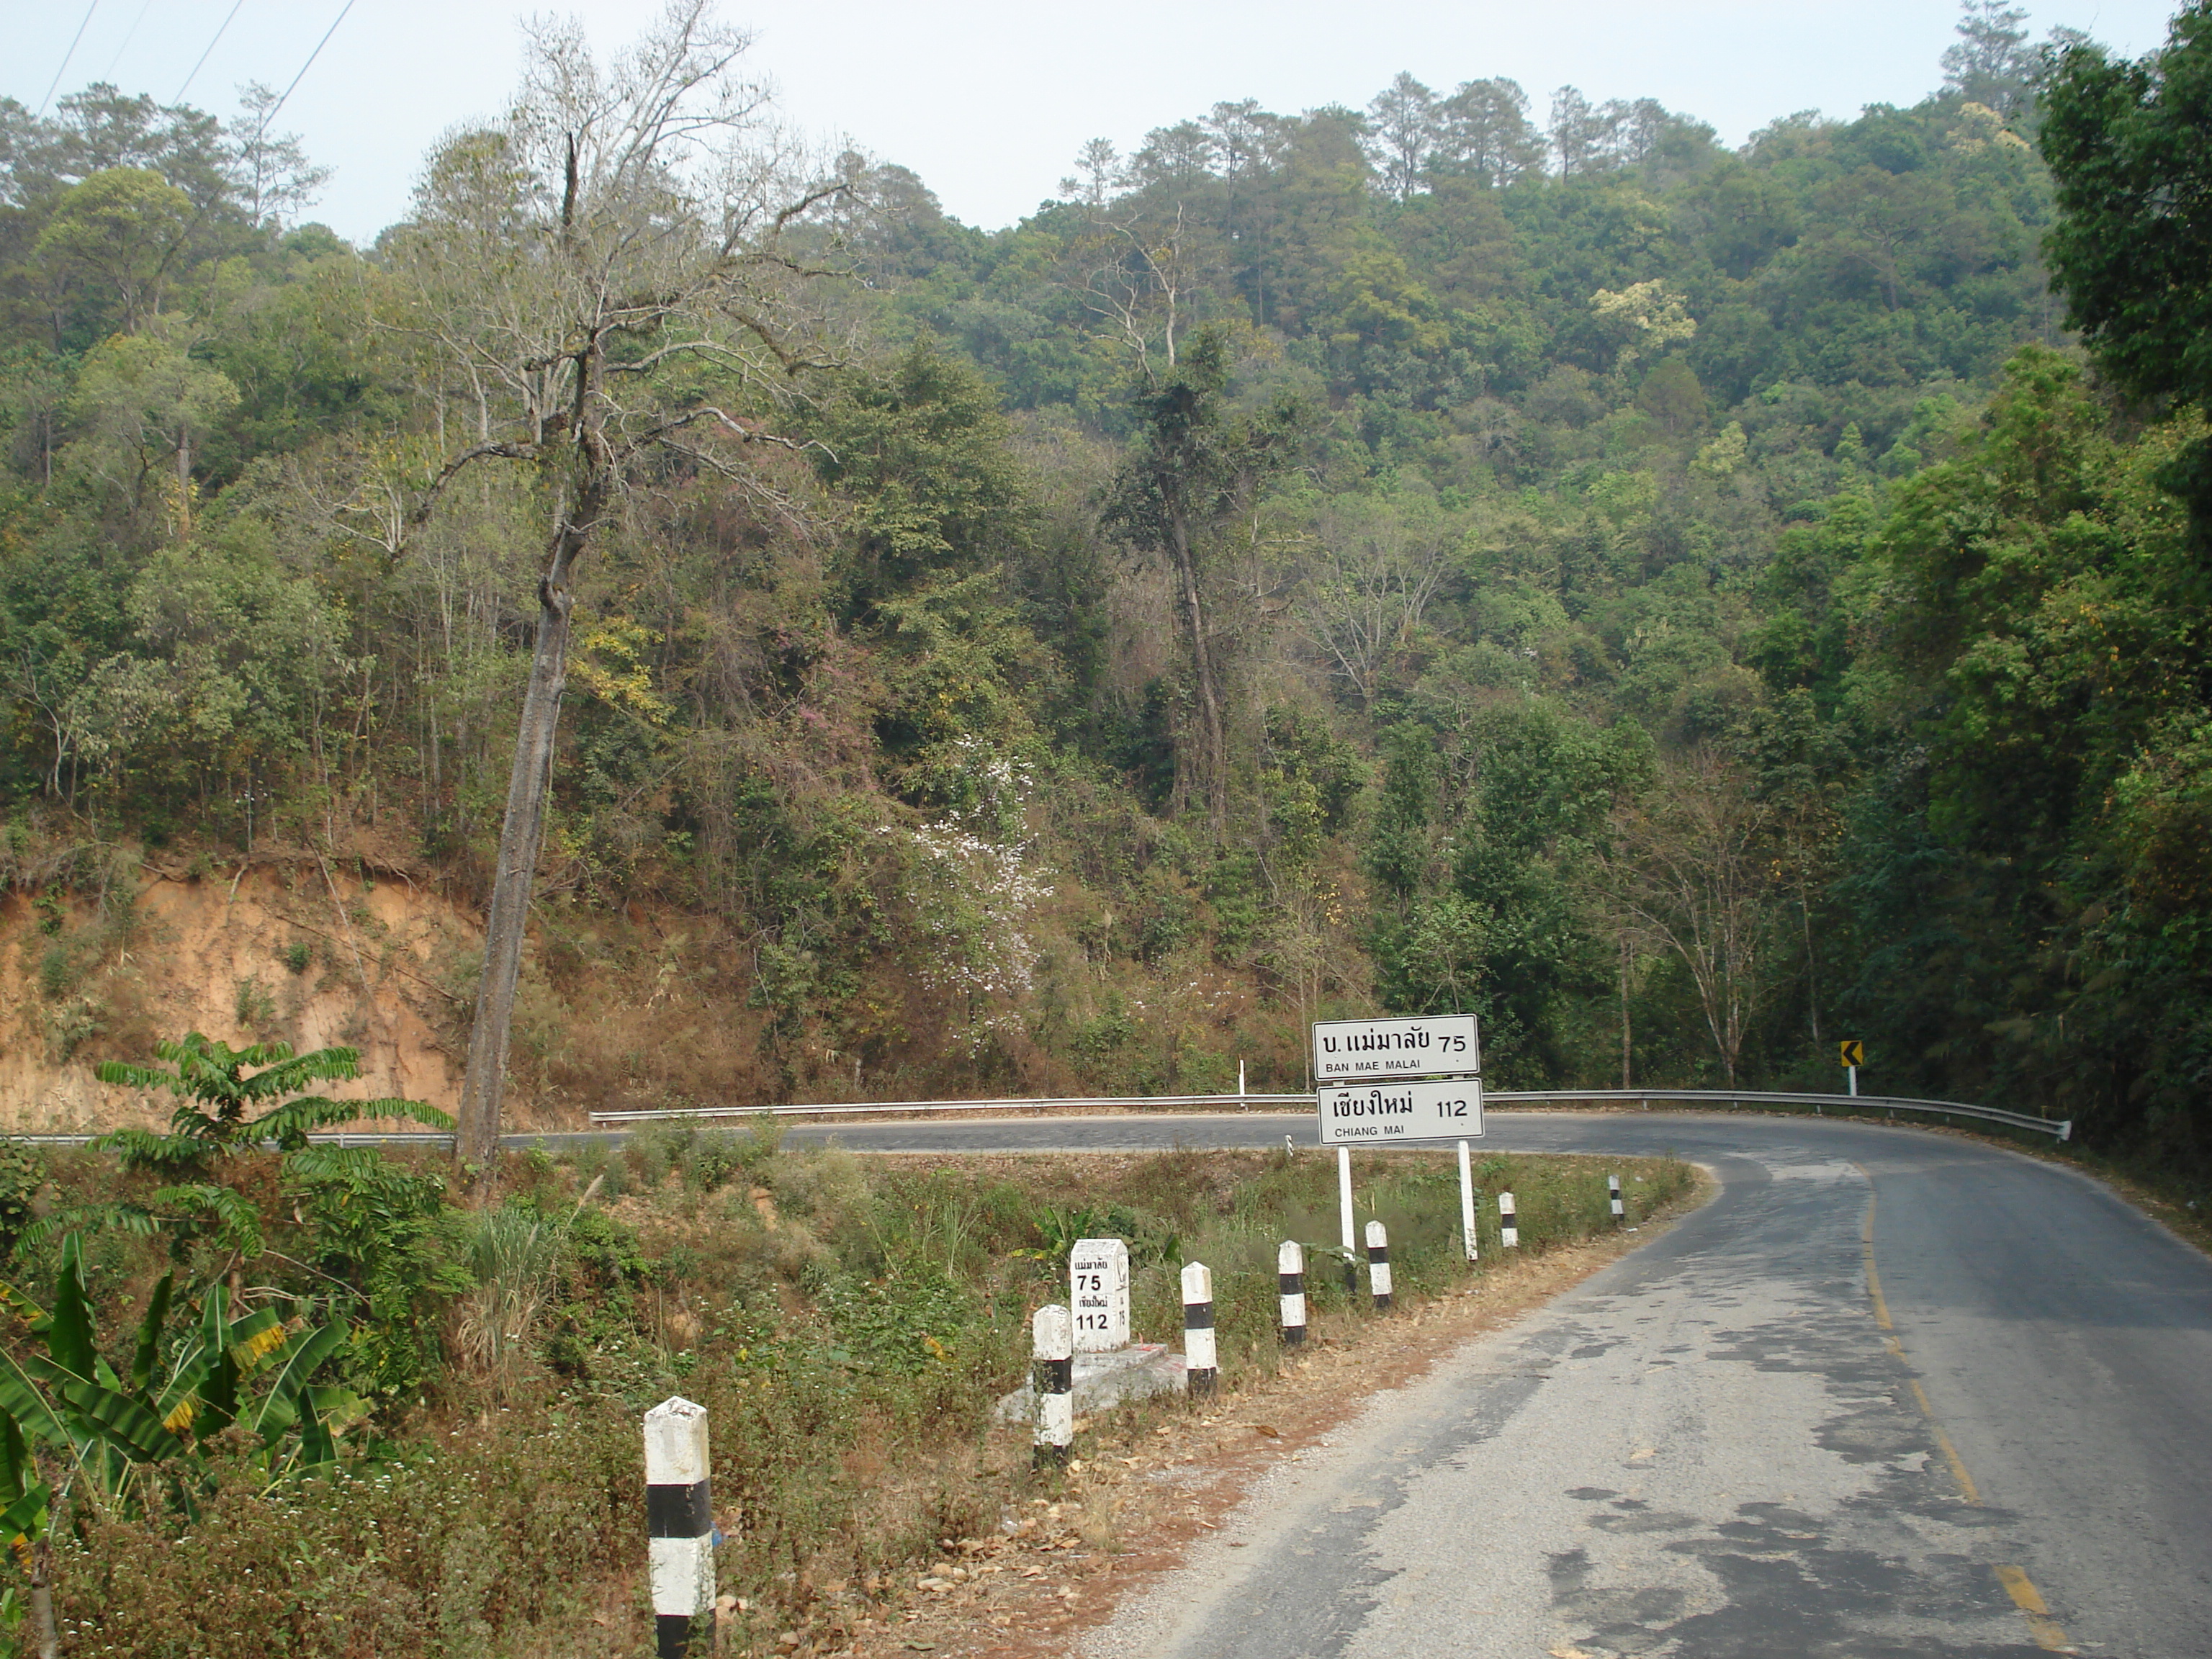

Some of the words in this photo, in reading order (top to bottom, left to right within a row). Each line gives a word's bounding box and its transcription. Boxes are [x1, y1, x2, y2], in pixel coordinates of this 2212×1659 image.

[1323, 1036, 1341, 1053] บ.
[1347, 1026, 1430, 1052] แม่มาลัย
[1438, 1035, 1466, 1053] 75
[1326, 1063, 1349, 1072] BAN
[1355, 1061, 1380, 1071] MAE
[1385, 1059, 1421, 1069] MALAI
[1334, 1090, 1413, 1117] เชียงใหม่
[1437, 1100, 1467, 1118] 112
[1335, 1127, 1377, 1137] CHIANG
[1384, 1125, 1404, 1135] MAI
[1077, 1275, 1101, 1290] 75
[1076, 1314, 1107, 1330] 112
